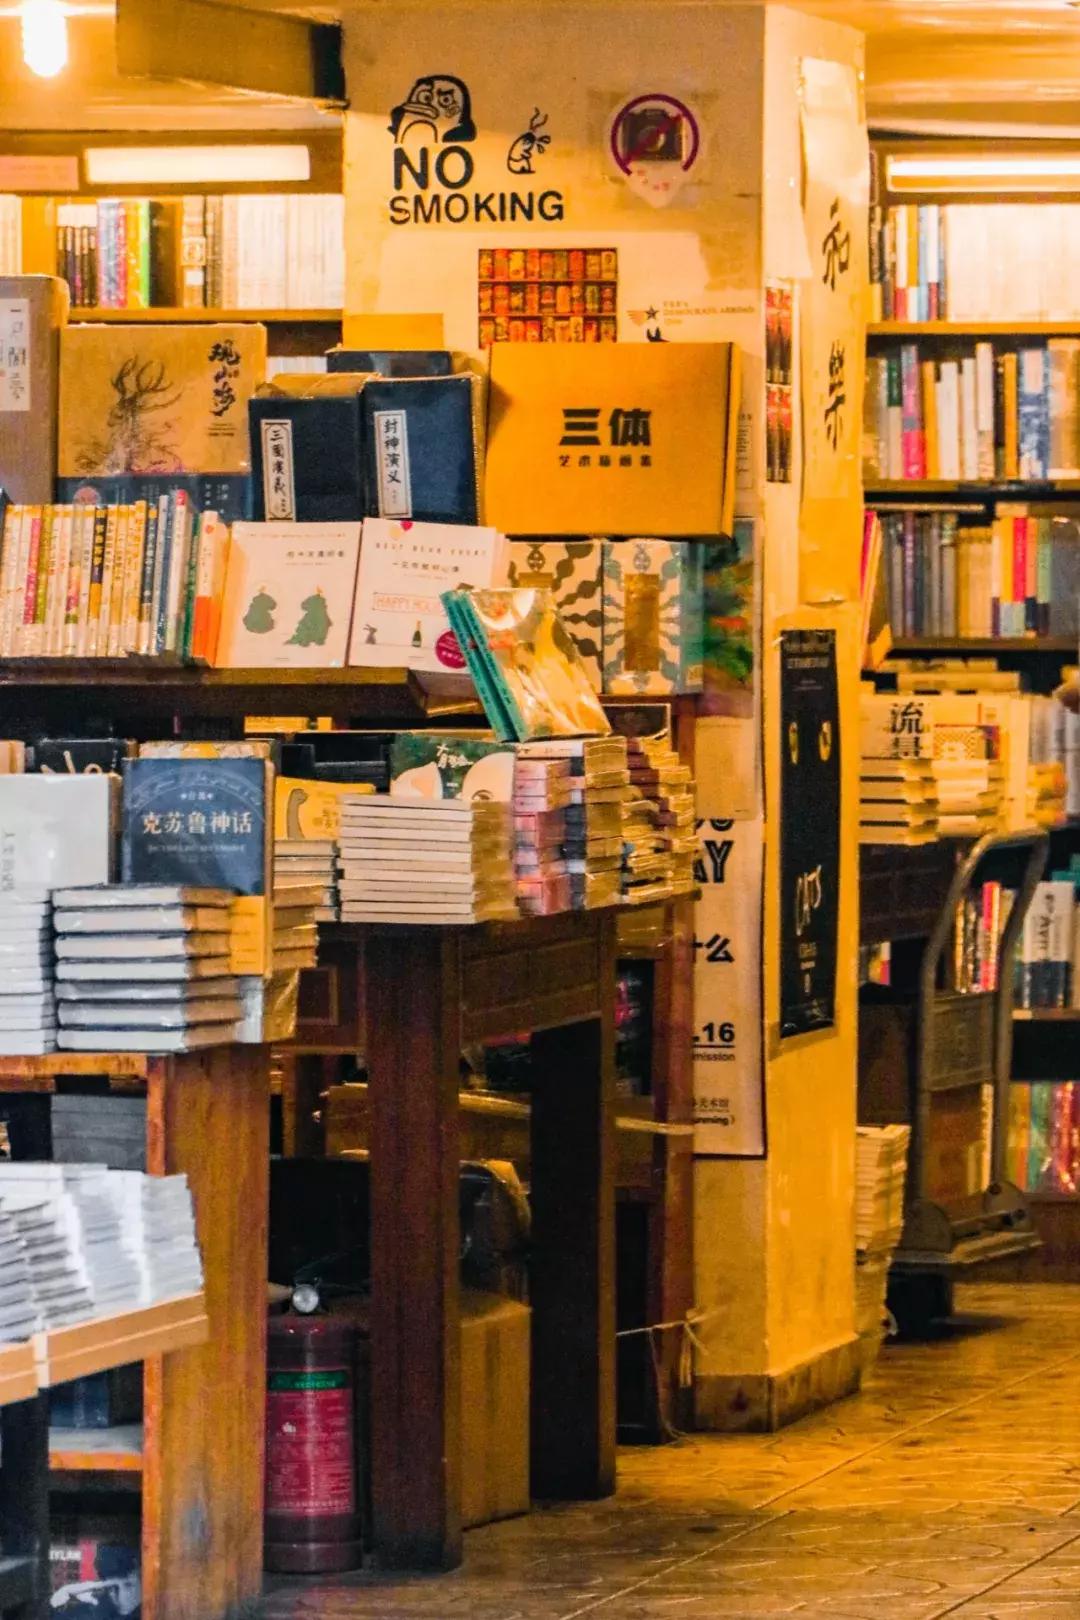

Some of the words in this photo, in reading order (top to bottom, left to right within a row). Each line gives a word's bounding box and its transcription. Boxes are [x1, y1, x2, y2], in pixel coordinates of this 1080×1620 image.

[393, 145, 474, 190] NO
[389, 191, 564, 225] SMOKING
[559, 408, 652, 446] 三体
[143, 811, 252, 835] 克苏鲁神话
